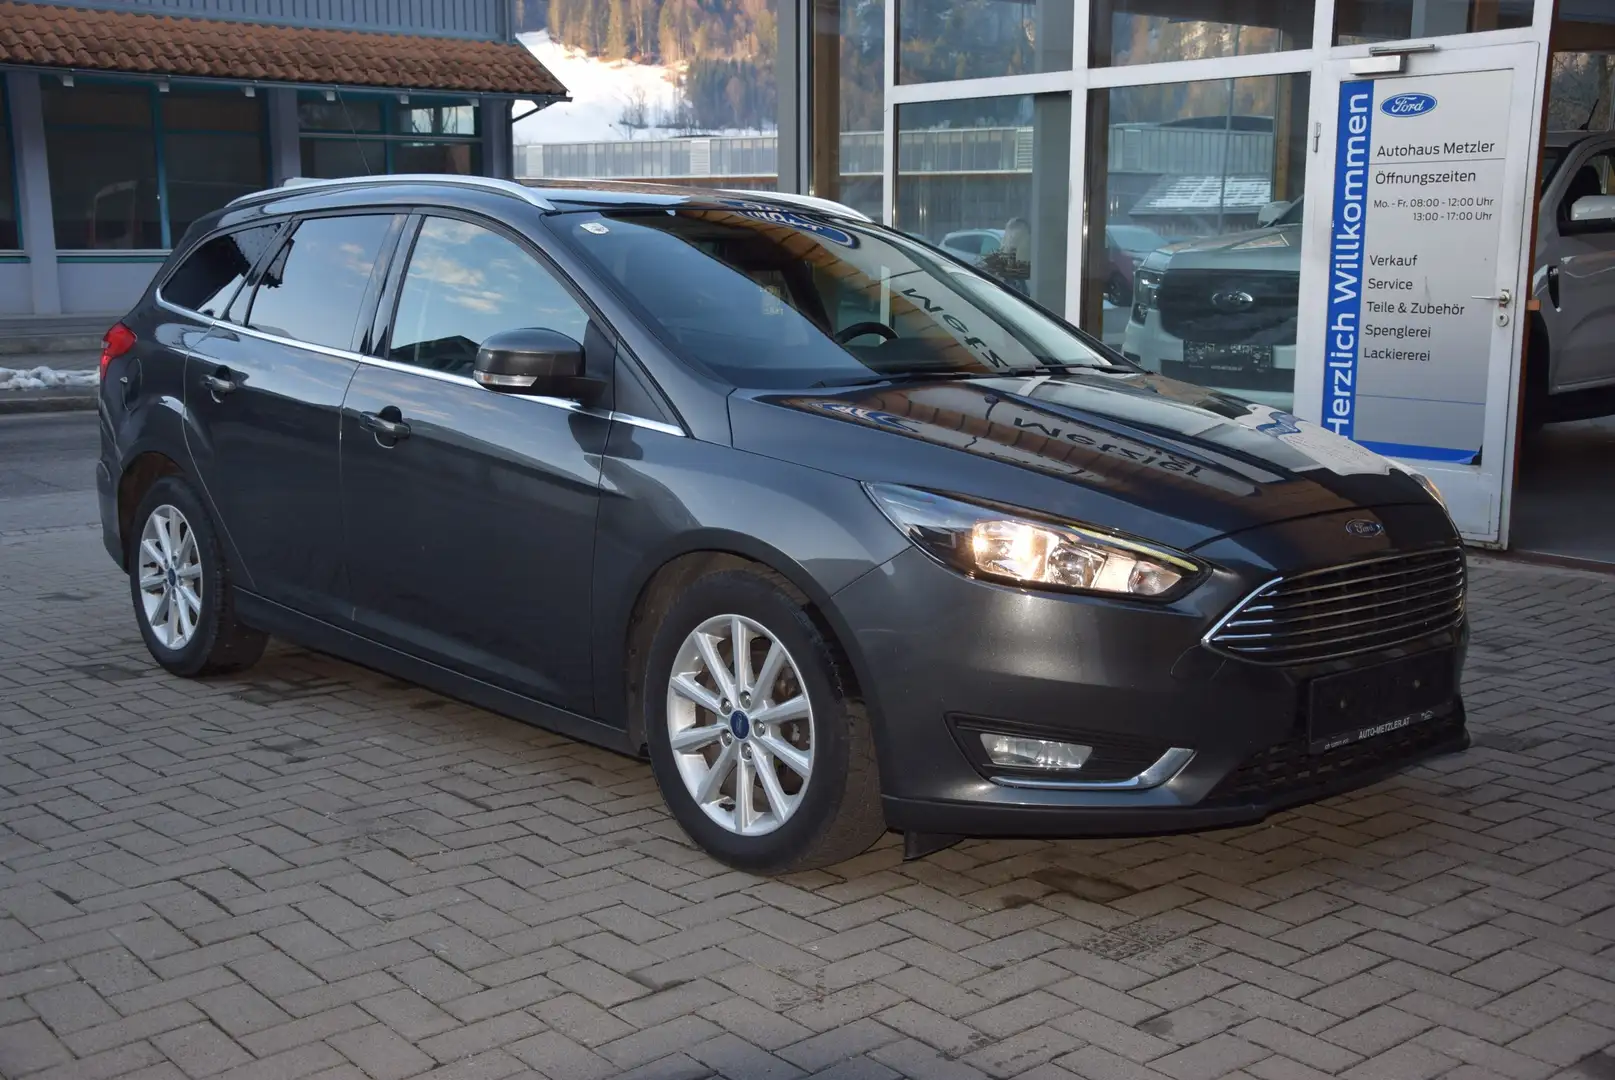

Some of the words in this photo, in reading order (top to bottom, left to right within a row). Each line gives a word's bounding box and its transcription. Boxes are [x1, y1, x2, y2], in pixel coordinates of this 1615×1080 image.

[1391, 95, 1425, 113] Ford
[1376, 144, 1440, 157] Autohaus
[1443, 141, 1496, 154] Metzler
[1375, 170, 1476, 186] Öffnungszeiten
[1333, 93, 1369, 304] Willkommen
[1373, 199, 1390, 208] Mo.
[1397, 199, 1408, 208] Fr.
[1409, 198, 1440, 208] 08:00
[1448, 197, 1474, 207] 12:00
[1476, 197, 1494, 207] Uhr
[1412, 212, 1439, 222] 13:00
[1446, 211, 1473, 221] 17:00
[1475, 211, 1493, 221] Uhr
[1369, 254, 1418, 267] Verkauf
[1367, 278, 1413, 290] Service
[1366, 301, 1395, 314] Teile
[1397, 303, 1407, 314] &
[1410, 302, 1465, 316] Zubehör
[1364, 324, 1431, 340] Spenglerei
[1363, 347, 1431, 362] Lackiererei
[1327, 312, 1355, 440] Herzlich
[1358, 716, 1411, 740] AUTO-METZLER.AT
